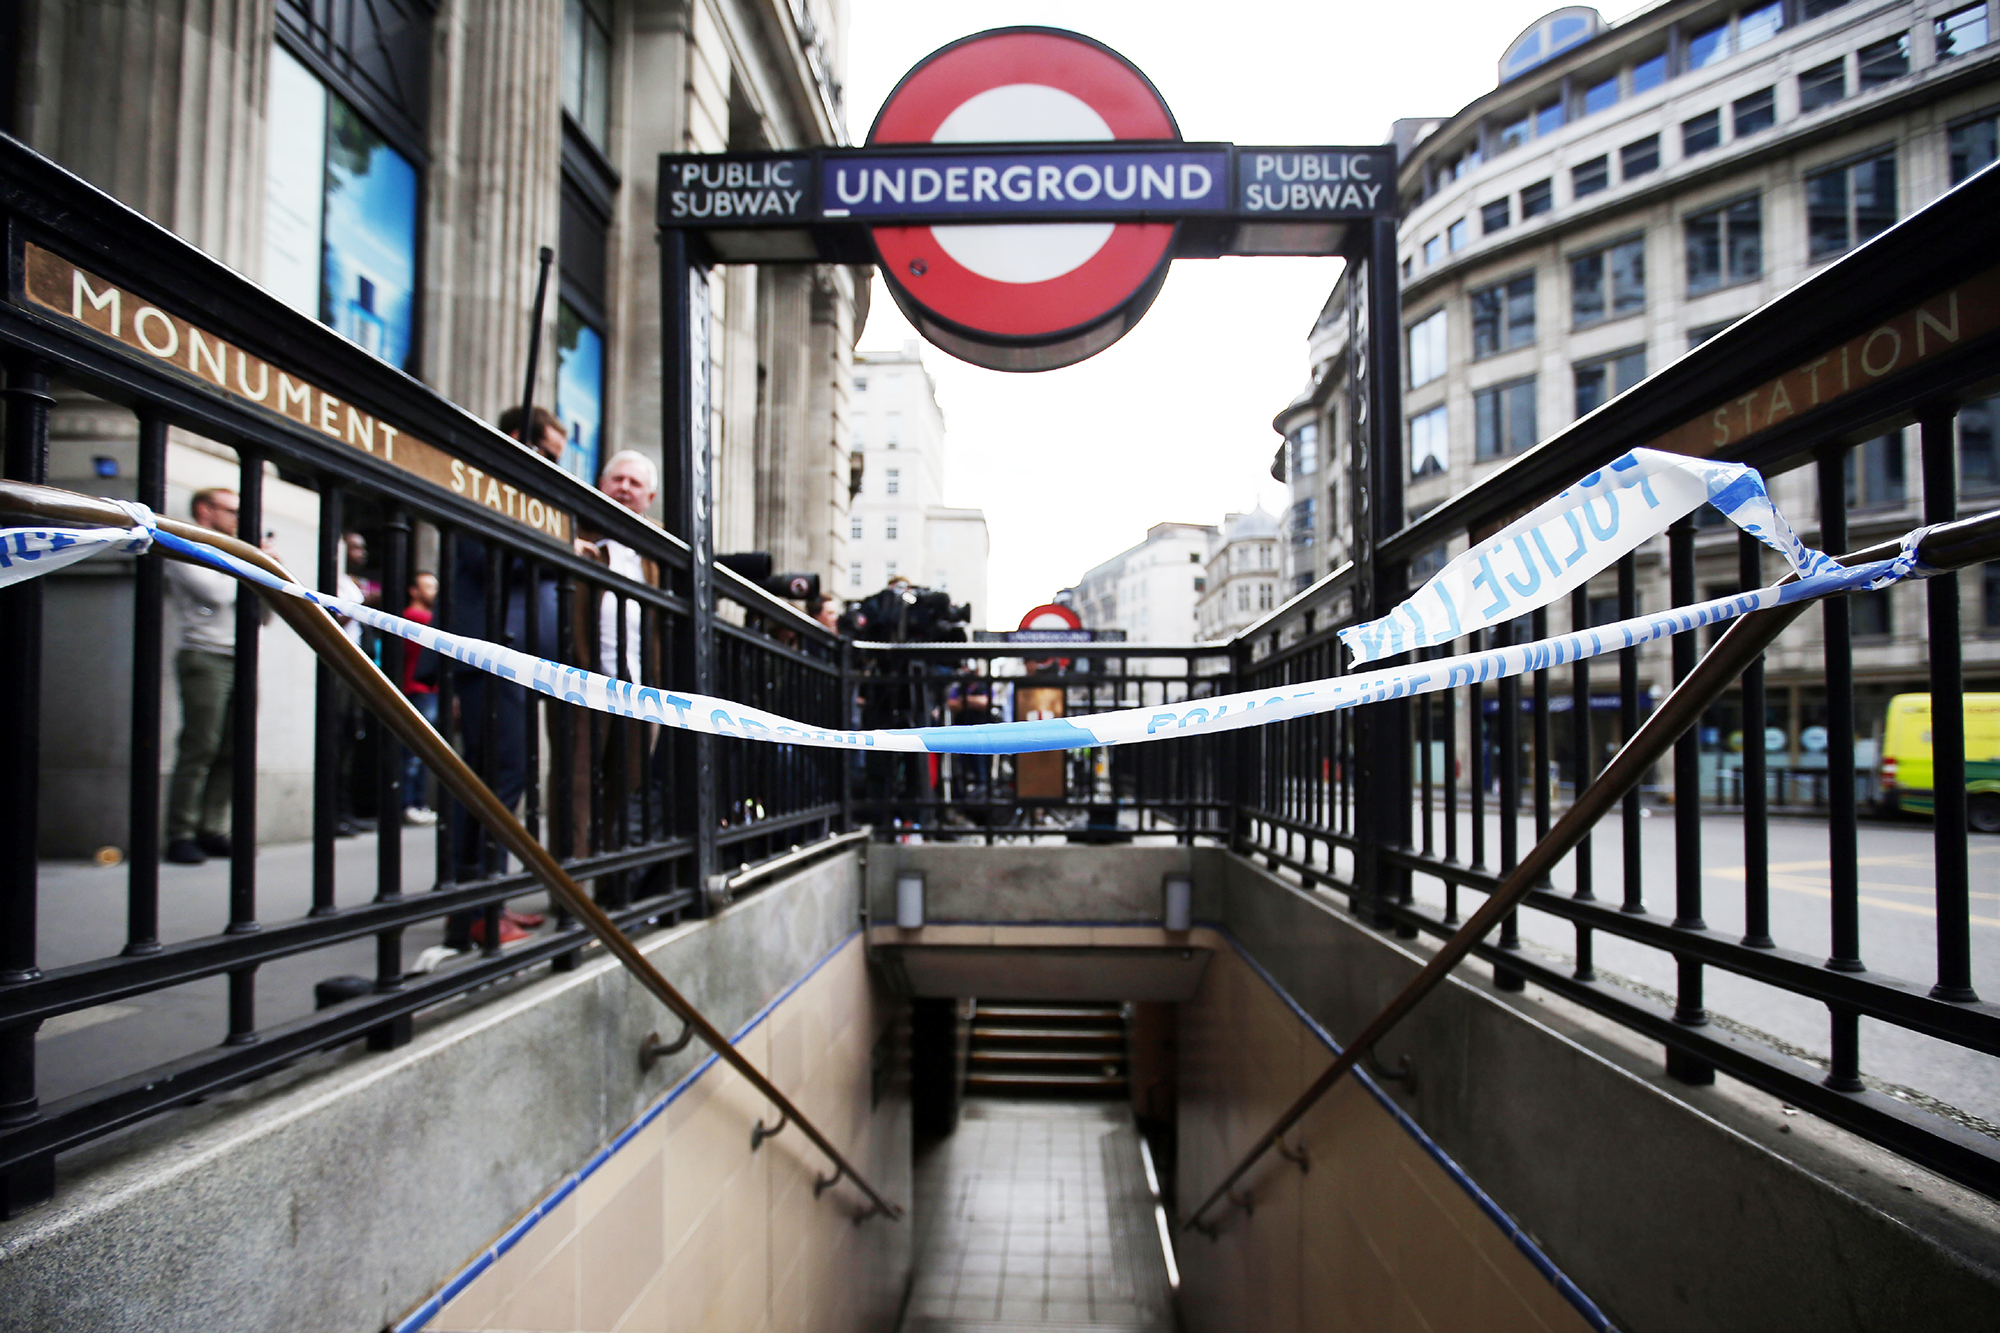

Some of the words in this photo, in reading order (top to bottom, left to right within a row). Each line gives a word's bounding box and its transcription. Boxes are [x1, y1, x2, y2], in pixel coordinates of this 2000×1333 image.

[682, 160, 794, 189] PUBLIC
[1255, 153, 1372, 182] PUBLIC
[835, 163, 1213, 205] UNDERGROUND
[1246, 183, 1383, 211] SUBWAY
[670, 189, 803, 218] SUBWAY
[1712, 291, 1960, 448] STATION
[72, 269, 399, 462] MONUMENT
[450, 458, 562, 537] STATION
